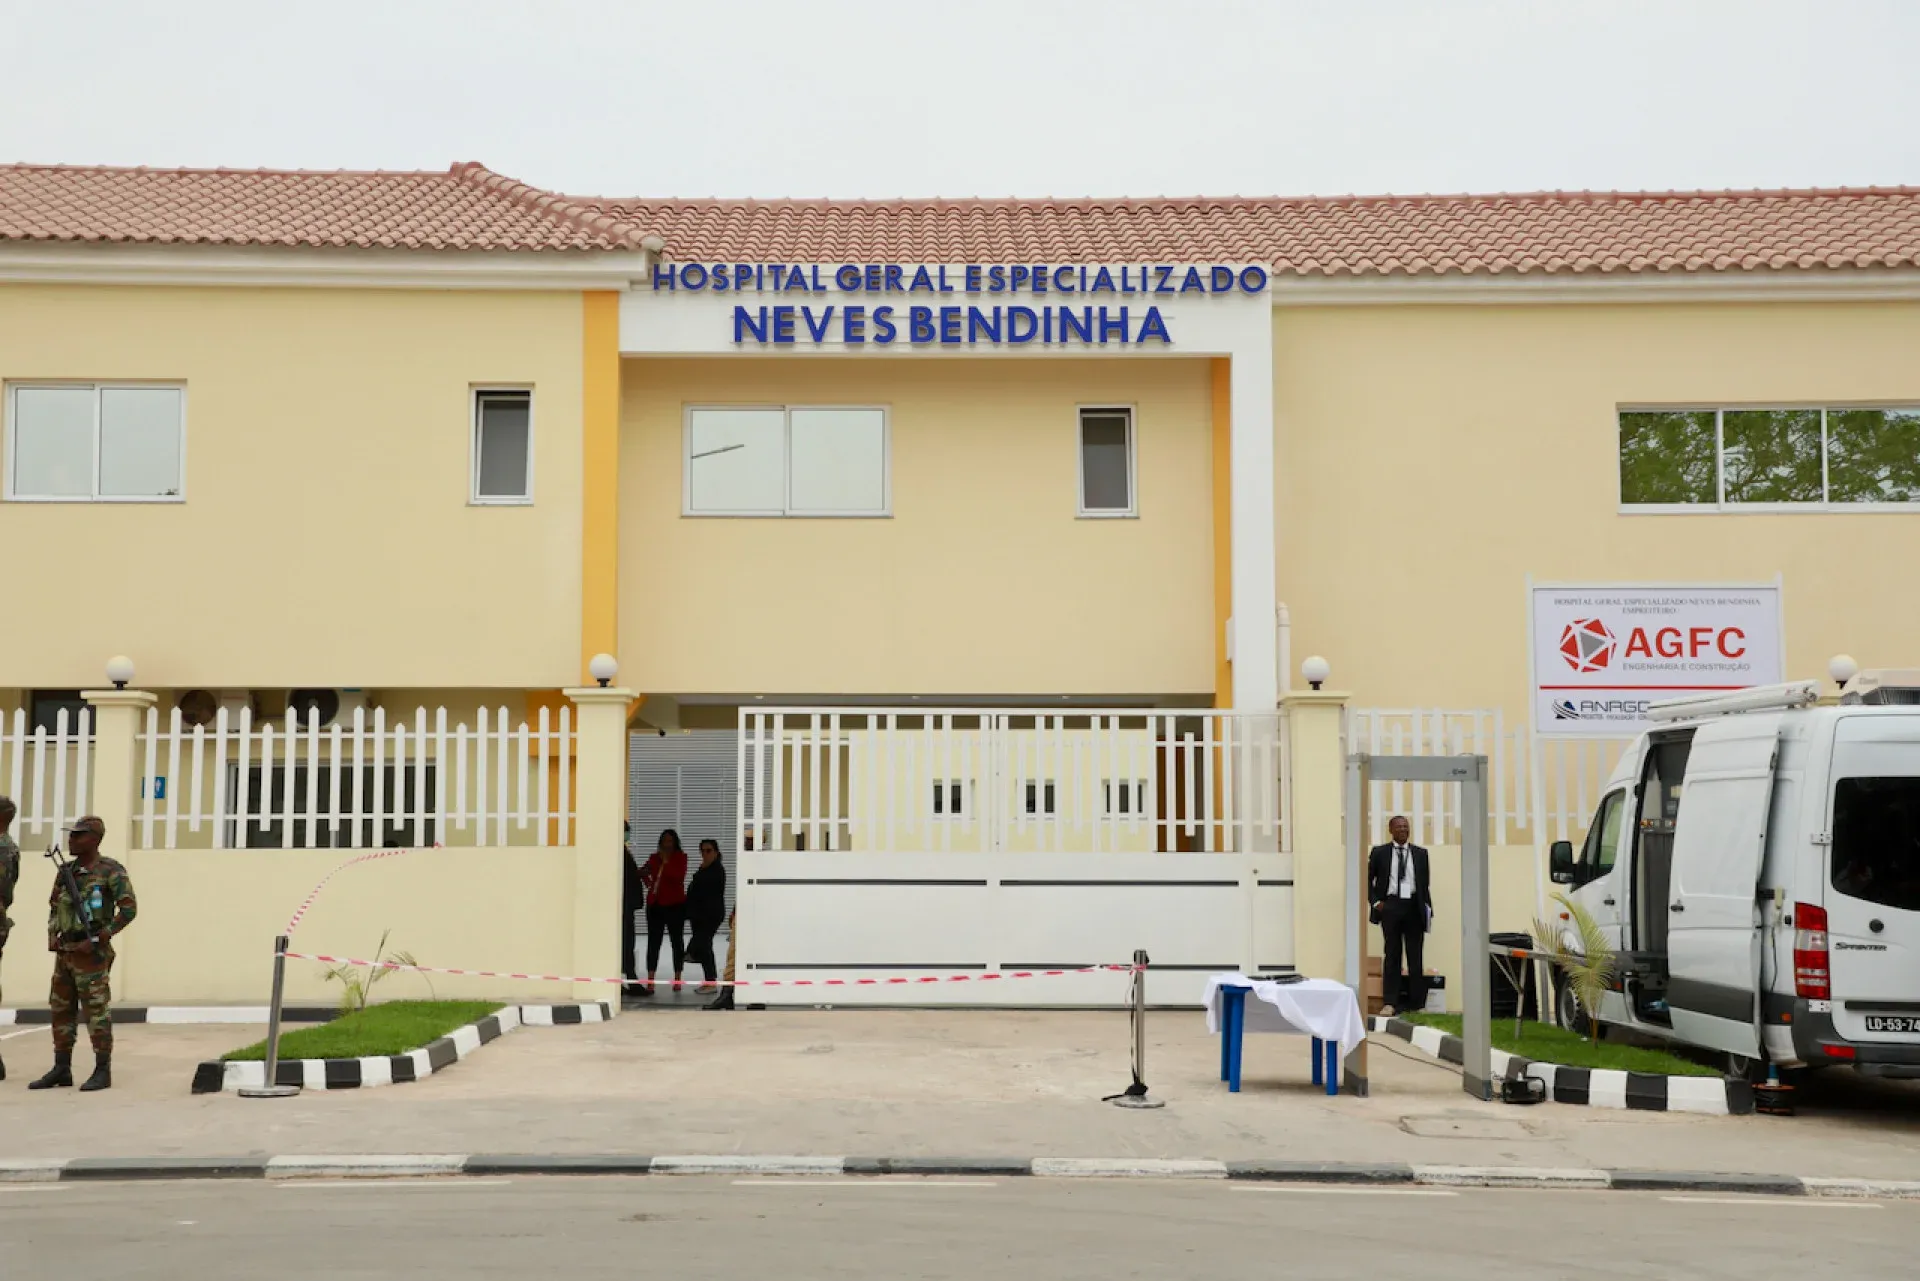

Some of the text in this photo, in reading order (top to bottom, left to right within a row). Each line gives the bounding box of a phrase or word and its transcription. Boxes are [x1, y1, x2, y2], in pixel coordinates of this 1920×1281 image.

[653, 263, 1267, 293] HOSPITAL GERAL ESPECIALIZADO
[733, 305, 1171, 343] NEVES BENDINHA
[1554, 598, 1593, 606] HOSPITAL
[1594, 598, 1622, 606] GERAL
[1625, 627, 1746, 658] AGFC
[1622, 663, 1679, 671] ENGENHARIA
[1680, 663, 1687, 671] E
